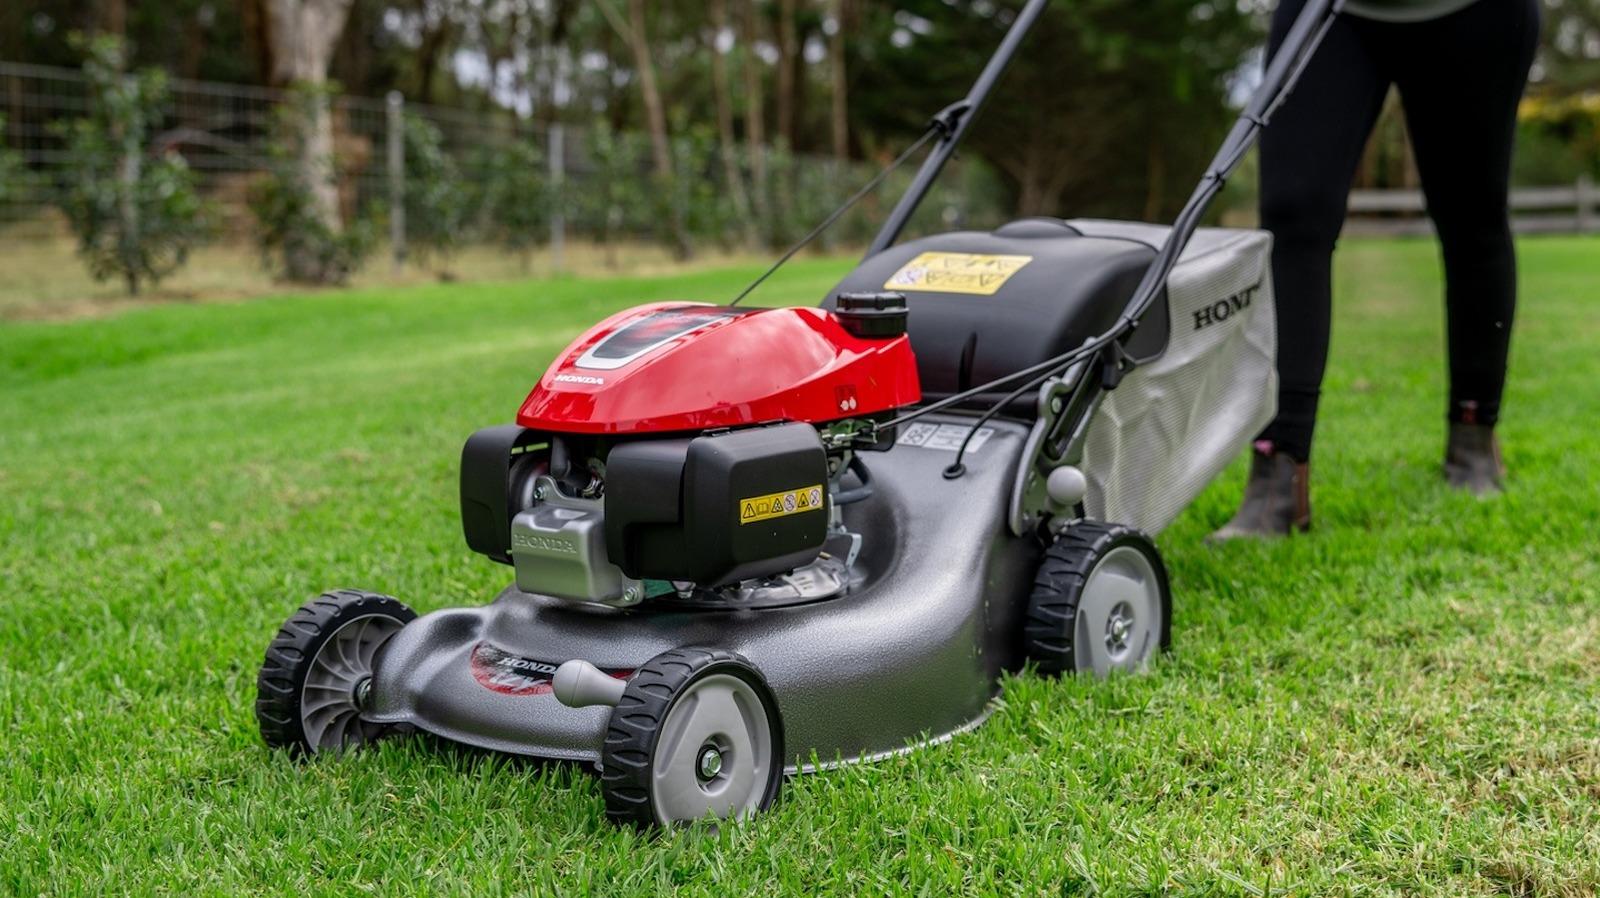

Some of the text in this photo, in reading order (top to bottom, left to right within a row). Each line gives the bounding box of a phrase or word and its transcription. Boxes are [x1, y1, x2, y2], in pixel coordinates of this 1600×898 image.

[554, 374, 604, 385] HONDA
[514, 534, 577, 554] HONDA
[498, 657, 558, 675] HOND
